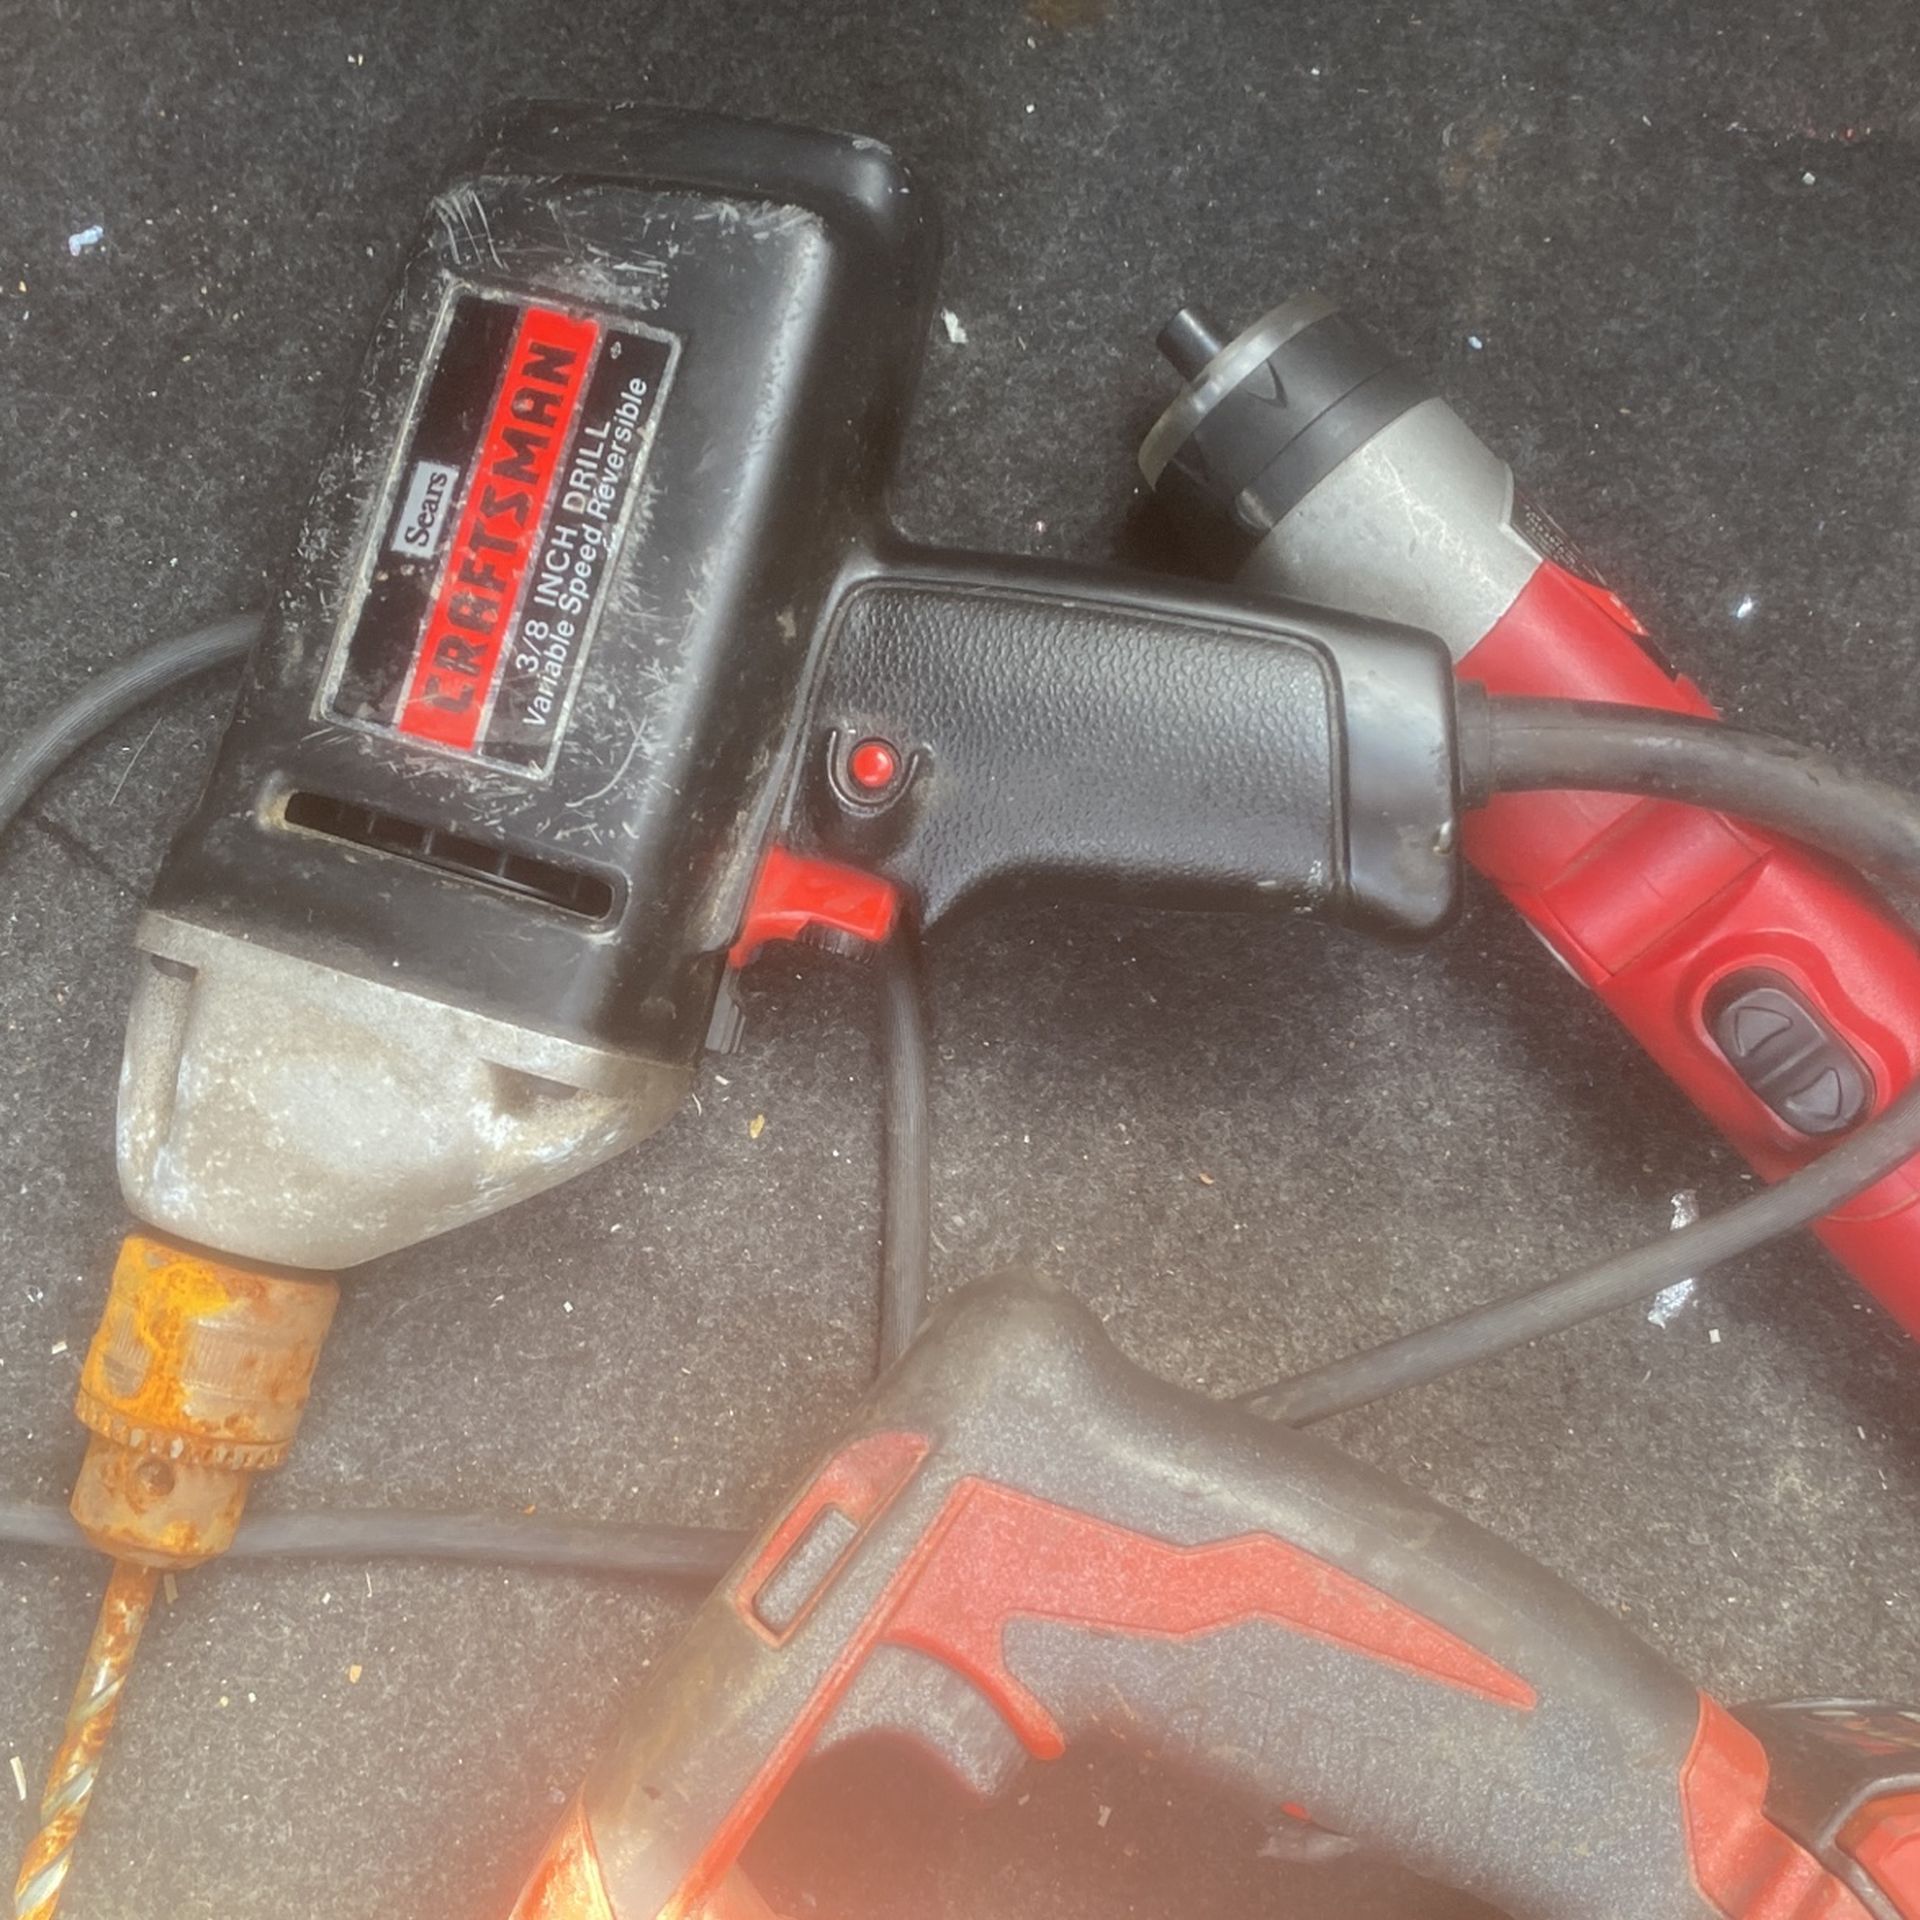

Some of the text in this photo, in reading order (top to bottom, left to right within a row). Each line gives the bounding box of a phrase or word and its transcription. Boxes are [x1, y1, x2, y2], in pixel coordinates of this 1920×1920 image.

[405, 471, 448, 547] Sears
[425, 342, 578, 714] CRAFTSMAN
[516, 420, 611, 674] 3/8 INCH DRILL
[522, 377, 648, 728] Variable Speed Reversible
